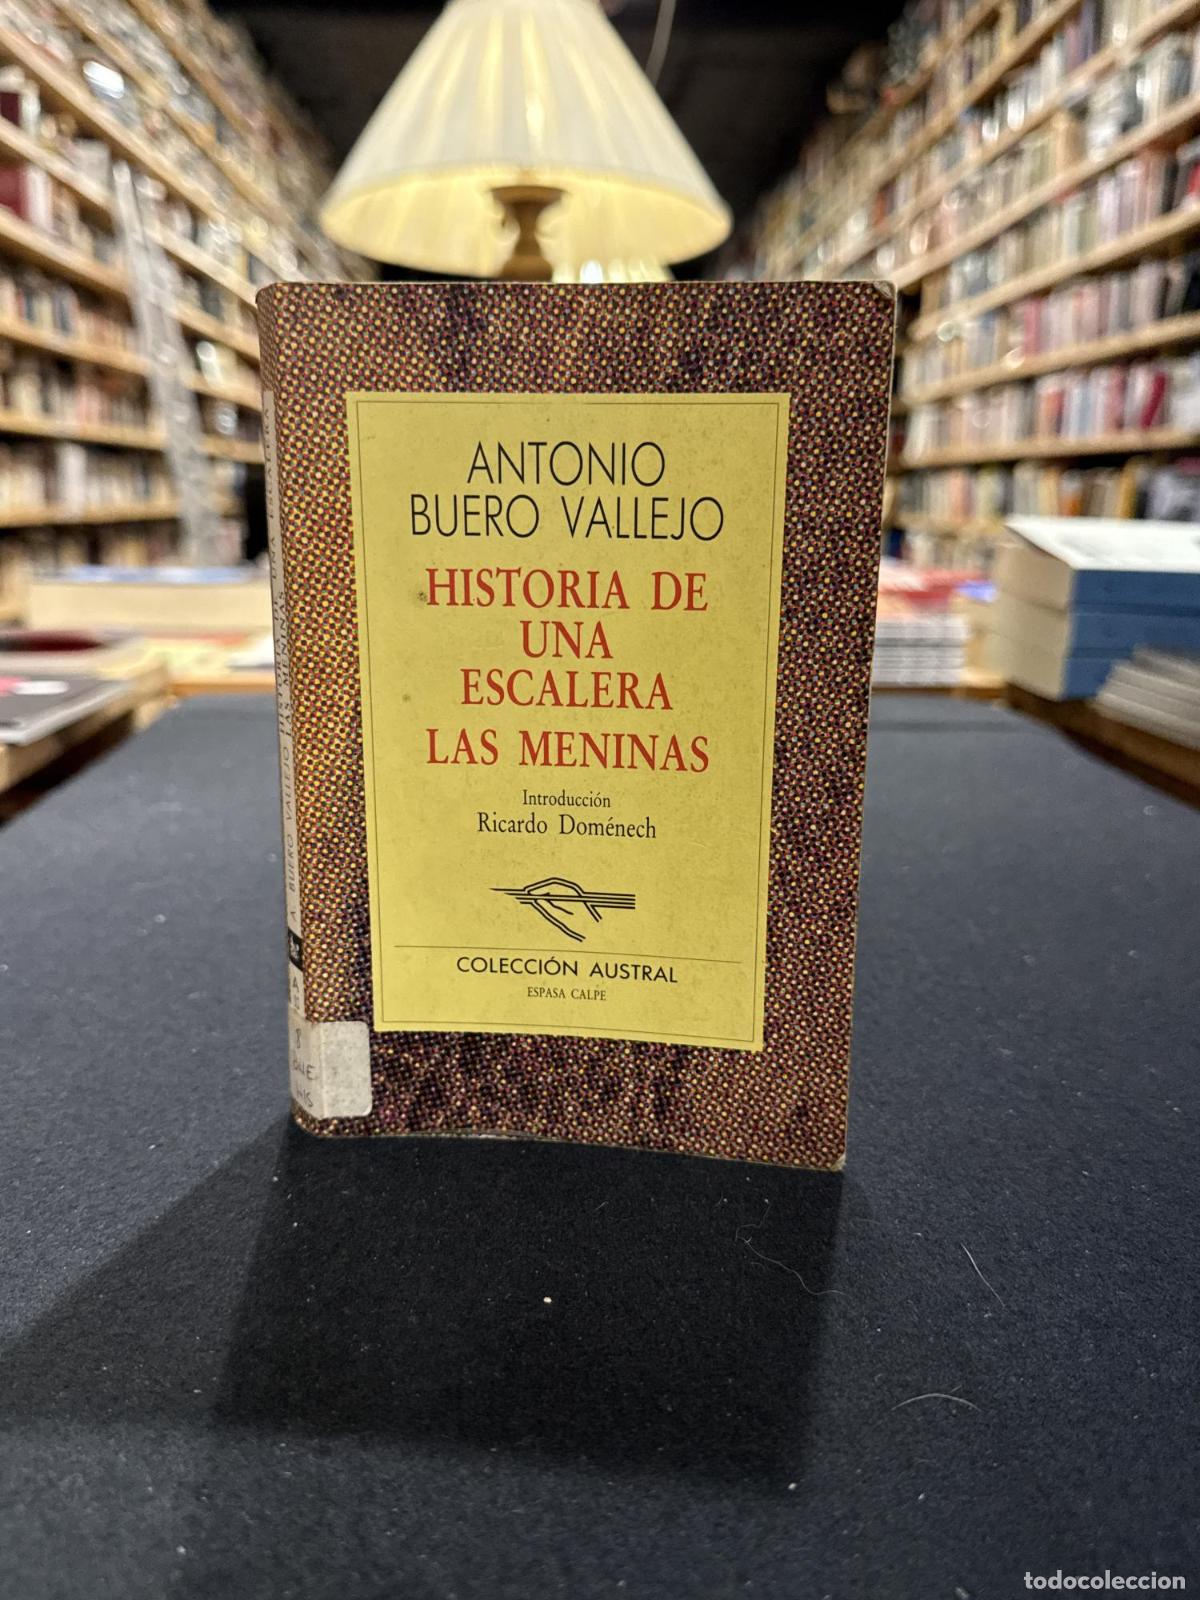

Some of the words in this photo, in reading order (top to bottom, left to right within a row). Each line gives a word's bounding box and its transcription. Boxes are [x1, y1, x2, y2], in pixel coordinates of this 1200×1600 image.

[467, 441, 666, 487] ANTONIO
[411, 494, 540, 539] BUERO
[561, 496, 725, 542] VALLEJO
[426, 567, 630, 610] HISTORIA
[651, 571, 709, 612] DE
[278, 591, 289, 686] MENINAS
[520, 620, 614, 660] UNA
[460, 668, 674, 711] ESCALERA
[284, 702, 292, 737] LAS
[426, 727, 499, 766] LAS
[518, 730, 709, 773] MENINAS
[283, 746, 293, 821] VALLEJO
[522, 789, 611, 808] Introducción
[477, 812, 548, 834] Ricardo
[559, 813, 657, 839] Doménech
[286, 833, 296, 893] BUERO
[456, 955, 579, 977] COLECCIÓN
[589, 961, 678, 984] AUSTRAL
[527, 986, 565, 999] ESPASA
[571, 989, 606, 1001] CALPE
